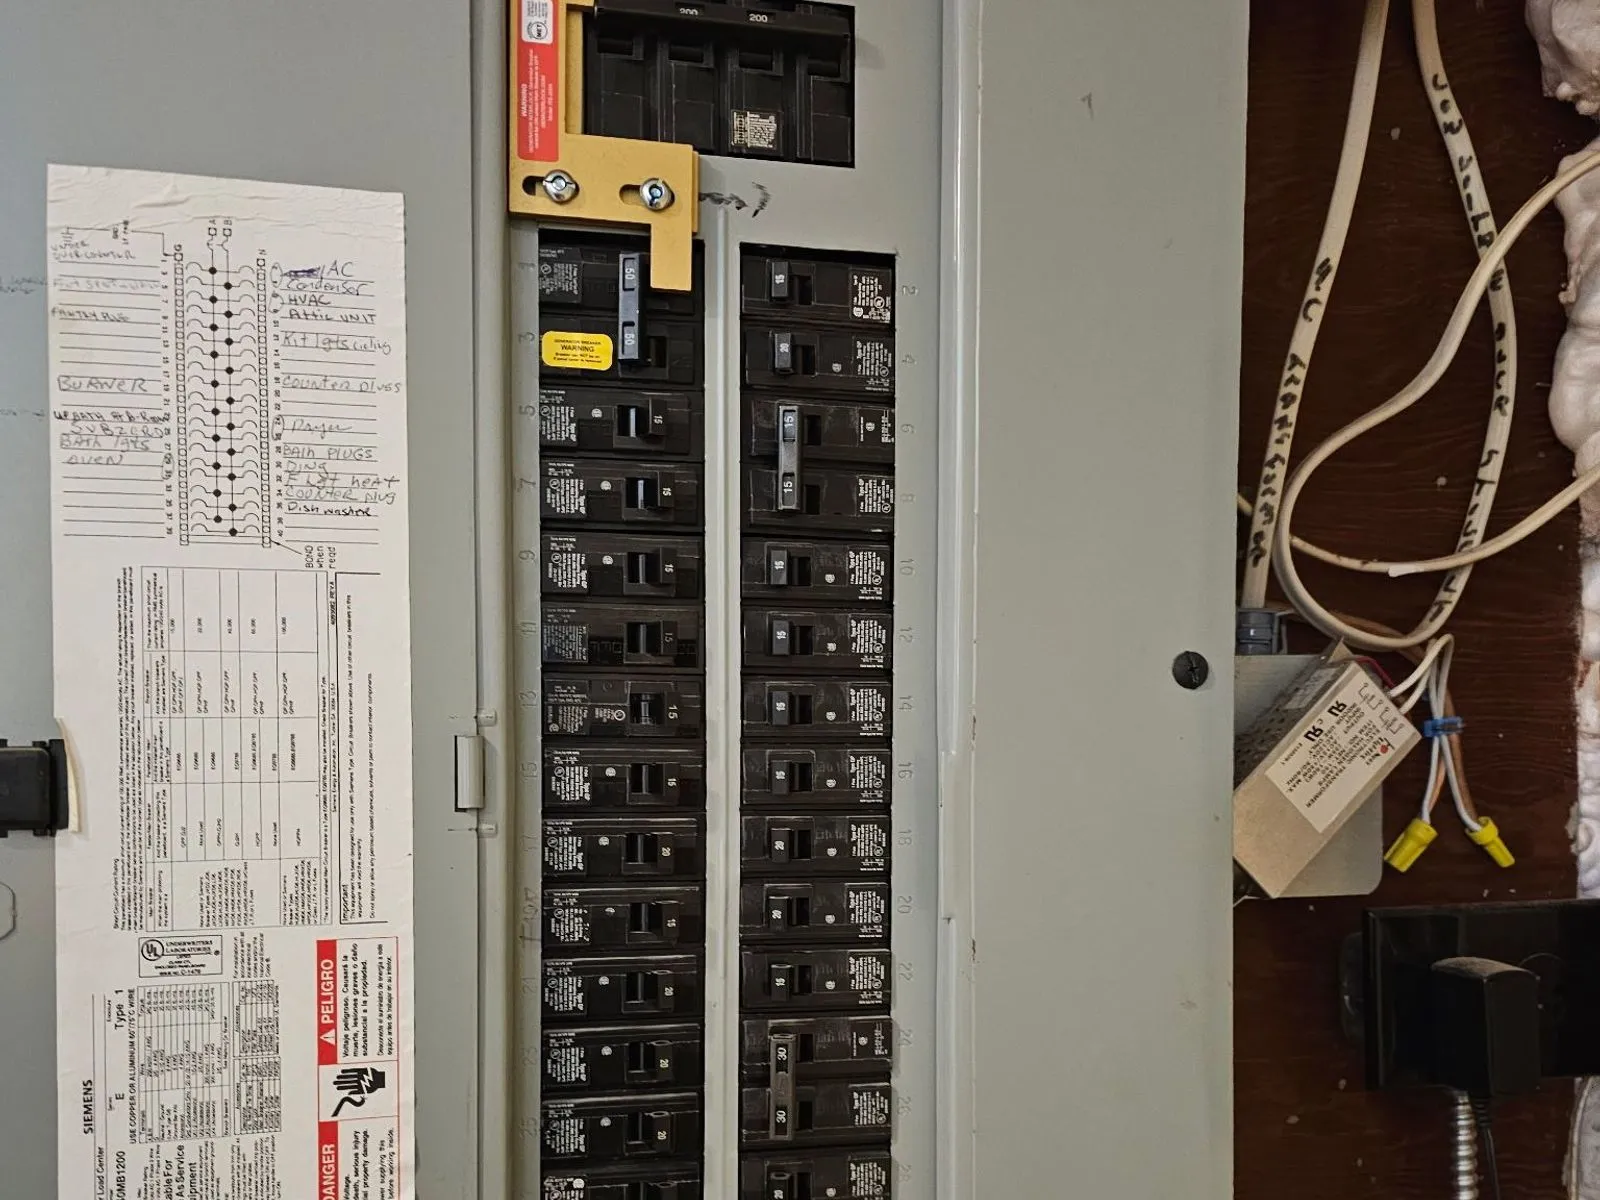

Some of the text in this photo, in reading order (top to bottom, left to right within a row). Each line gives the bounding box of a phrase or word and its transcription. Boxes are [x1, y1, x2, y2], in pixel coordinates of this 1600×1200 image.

[749, 14, 768, 22] 200
[327, 260, 356, 278] AC
[775, 274, 784, 284] 15
[288, 294, 332, 306] HVAC
[340, 314, 376, 323] UNIT
[519, 331, 536, 344] 3
[560, 344, 594, 352] WARNING
[780, 342, 790, 352] 20
[518, 405, 536, 417] 5
[654, 415, 663, 424] 15
[784, 415, 794, 427] 15
[662, 488, 672, 496] 15
[784, 481, 793, 493] 15
[304, 544, 314, 568] BOND
[316, 544, 325, 568] when
[519, 549, 536, 562] 9
[664, 564, 674, 573] 15
[774, 561, 784, 570] 15
[900, 558, 914, 576] 10
[664, 632, 674, 642] 15
[776, 631, 786, 639] 15
[900, 627, 913, 643] 12
[519, 690, 537, 708] 13
[898, 695, 912, 711] 14
[668, 705, 678, 719] 15
[776, 702, 785, 711] 15
[520, 762, 538, 781] 15
[776, 771, 785, 780] 15
[898, 762, 912, 780] 16
[667, 778, 677, 787] 15
[899, 829, 912, 846] 18
[775, 841, 784, 850] 20
[661, 847, 670, 857] 20
[898, 896, 912, 914] 20
[772, 909, 782, 919] 20
[667, 918, 676, 928] 15
[899, 962, 912, 981] 22
[775, 978, 785, 987] 15
[320, 959, 334, 1024] PELIGRO
[664, 987, 674, 996] 20
[114, 1004, 126, 1030] Type
[777, 1047, 787, 1061] 30
[128, 1041, 136, 1081] ALUMINUM
[660, 1058, 668, 1068] 20
[128, 1083, 136, 1094] OR
[82, 1079, 94, 1134] SIEMENS
[776, 1110, 786, 1123] 30
[658, 1131, 666, 1140] 20
[96, 1146, 105, 1196] Load Center
[175, 1145, 185, 1197] As Service
[322, 1144, 335, 1200] DANGER
[163, 1160, 173, 1200] able For
